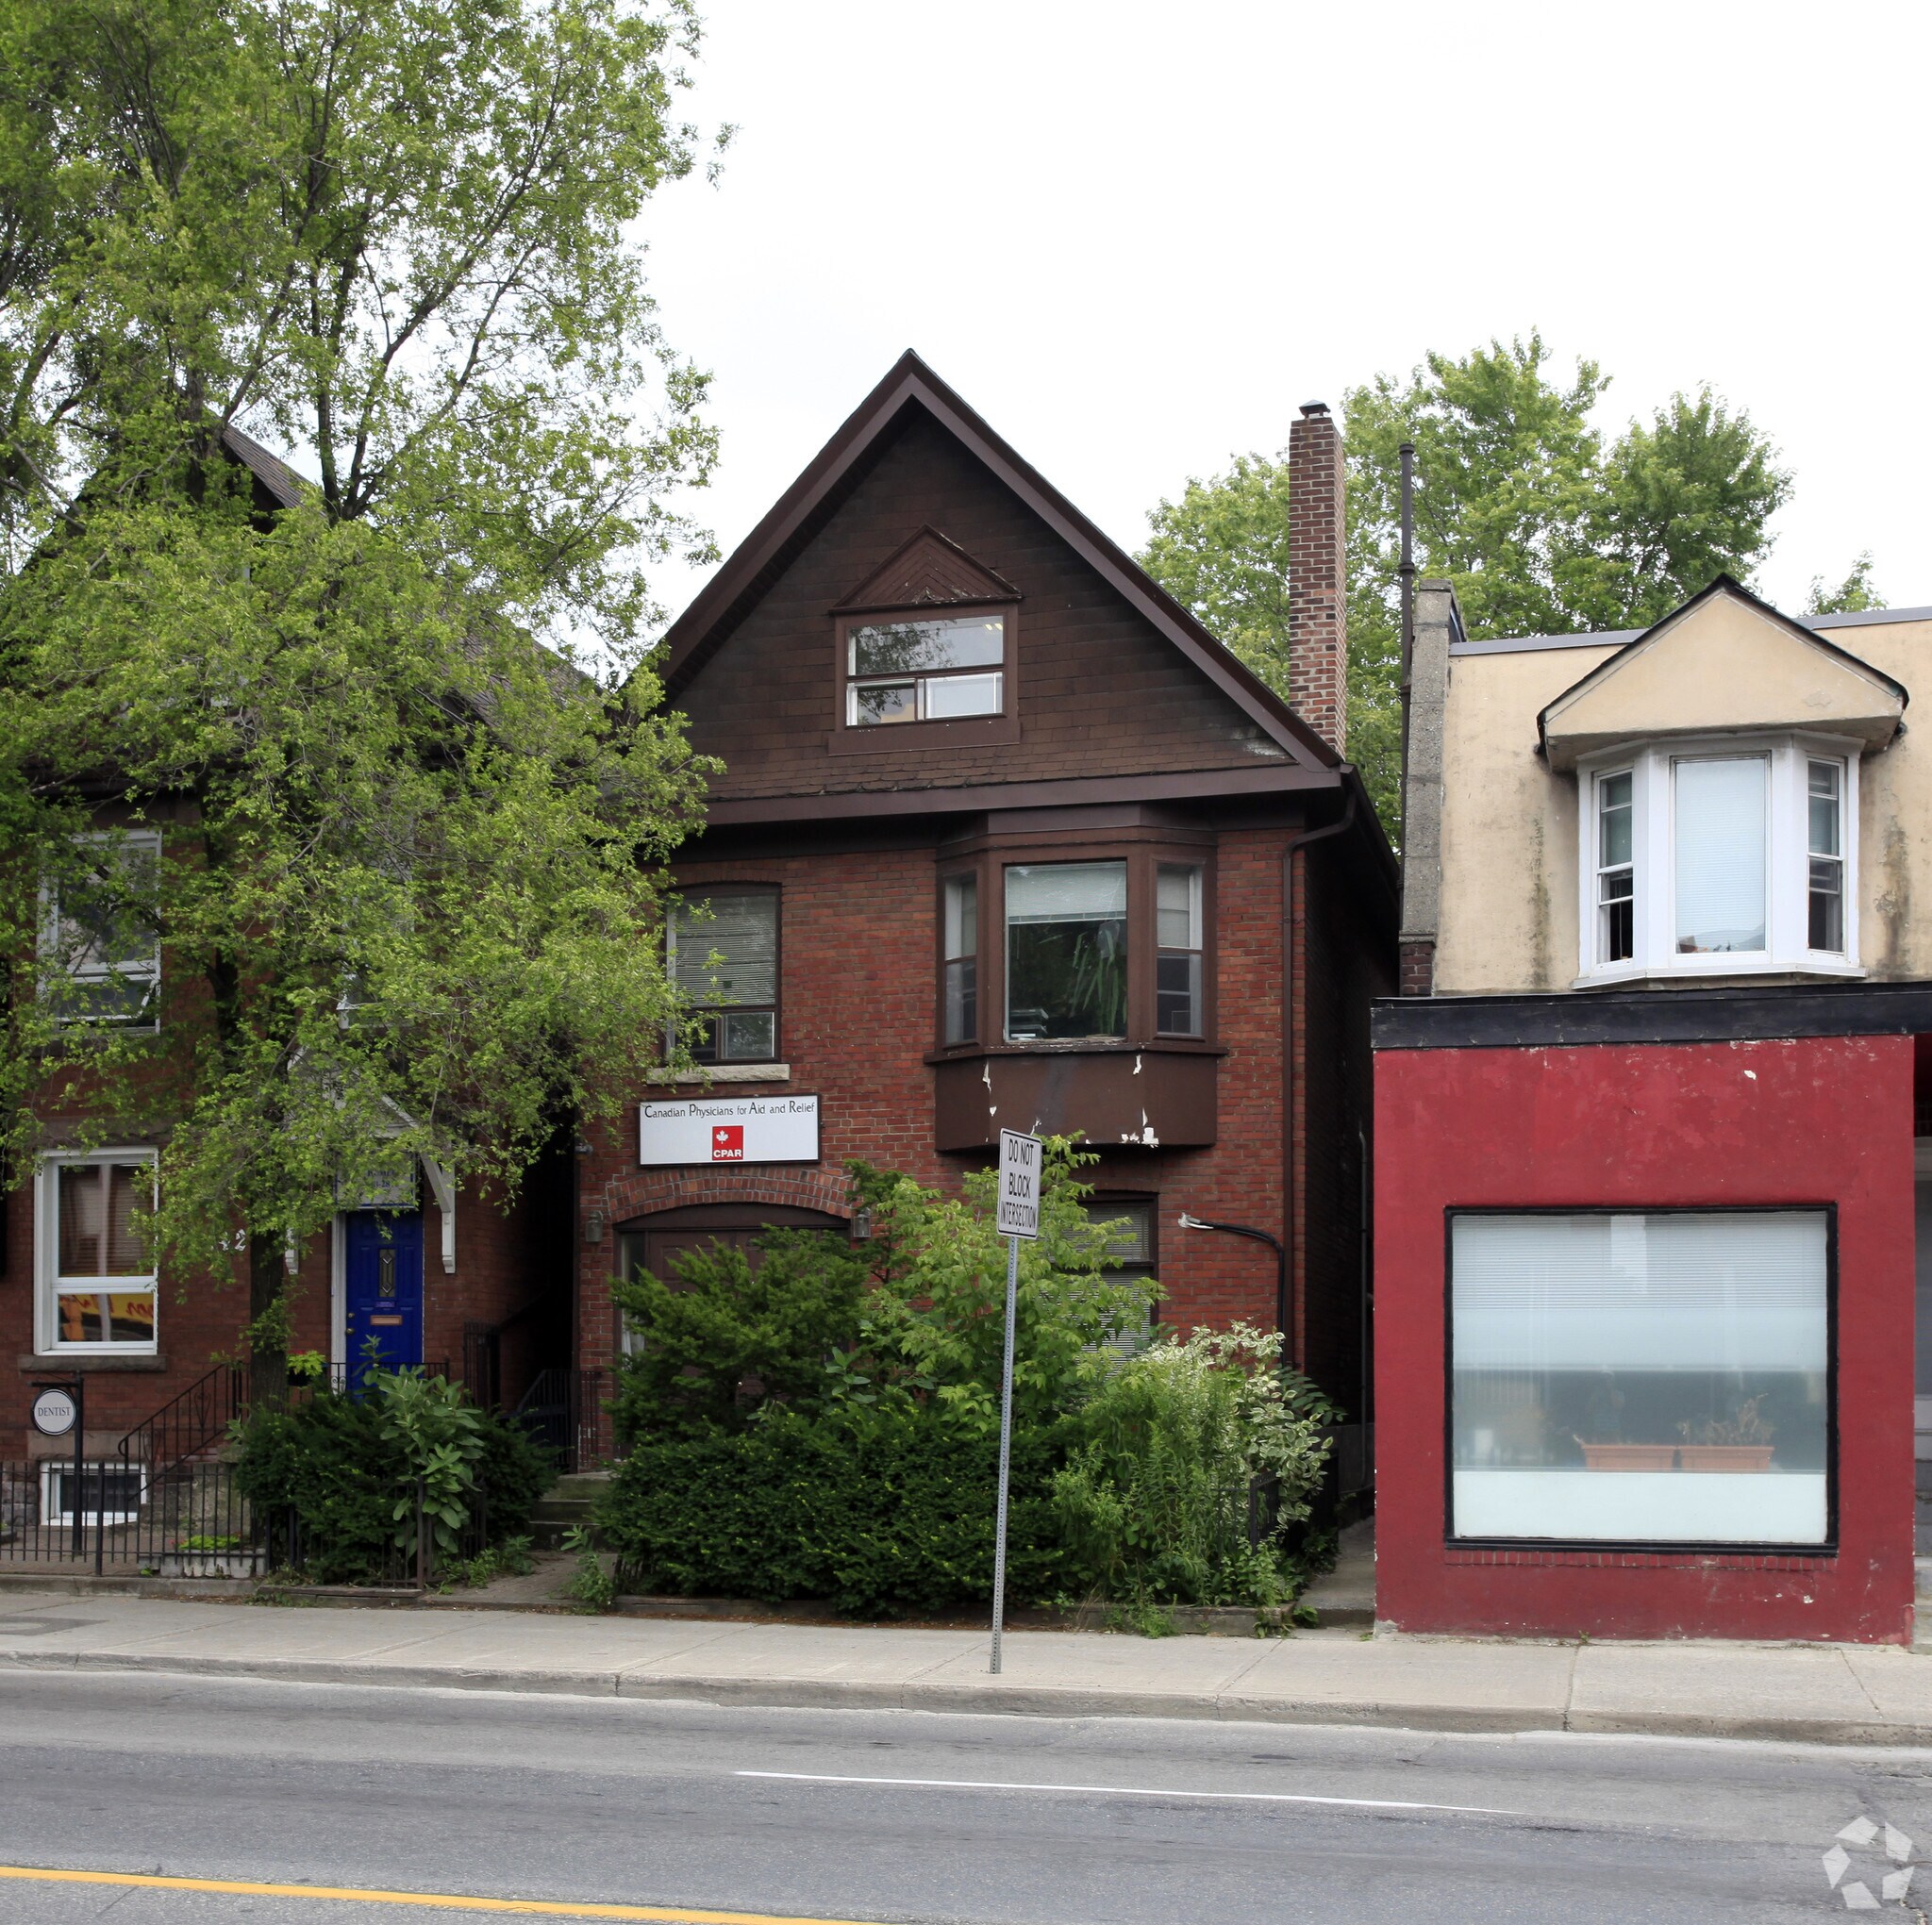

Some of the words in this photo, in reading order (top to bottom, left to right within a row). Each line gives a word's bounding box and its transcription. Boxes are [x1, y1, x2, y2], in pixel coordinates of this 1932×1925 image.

[644, 1104, 686, 1119] Canadian
[689, 1104, 734, 1119] Physicians
[737, 1104, 747, 1115] for
[748, 1102, 765, 1115] Aid
[769, 1103, 786, 1114] and
[789, 1100, 815, 1113] Relief
[713, 1149, 742, 1158] CPAR
[1008, 1138, 1018, 1162] DO
[1020, 1142, 1034, 1166] NOT
[1008, 1172, 1031, 1199] BLOCK
[38, 1406, 71, 1416] DENTIST
